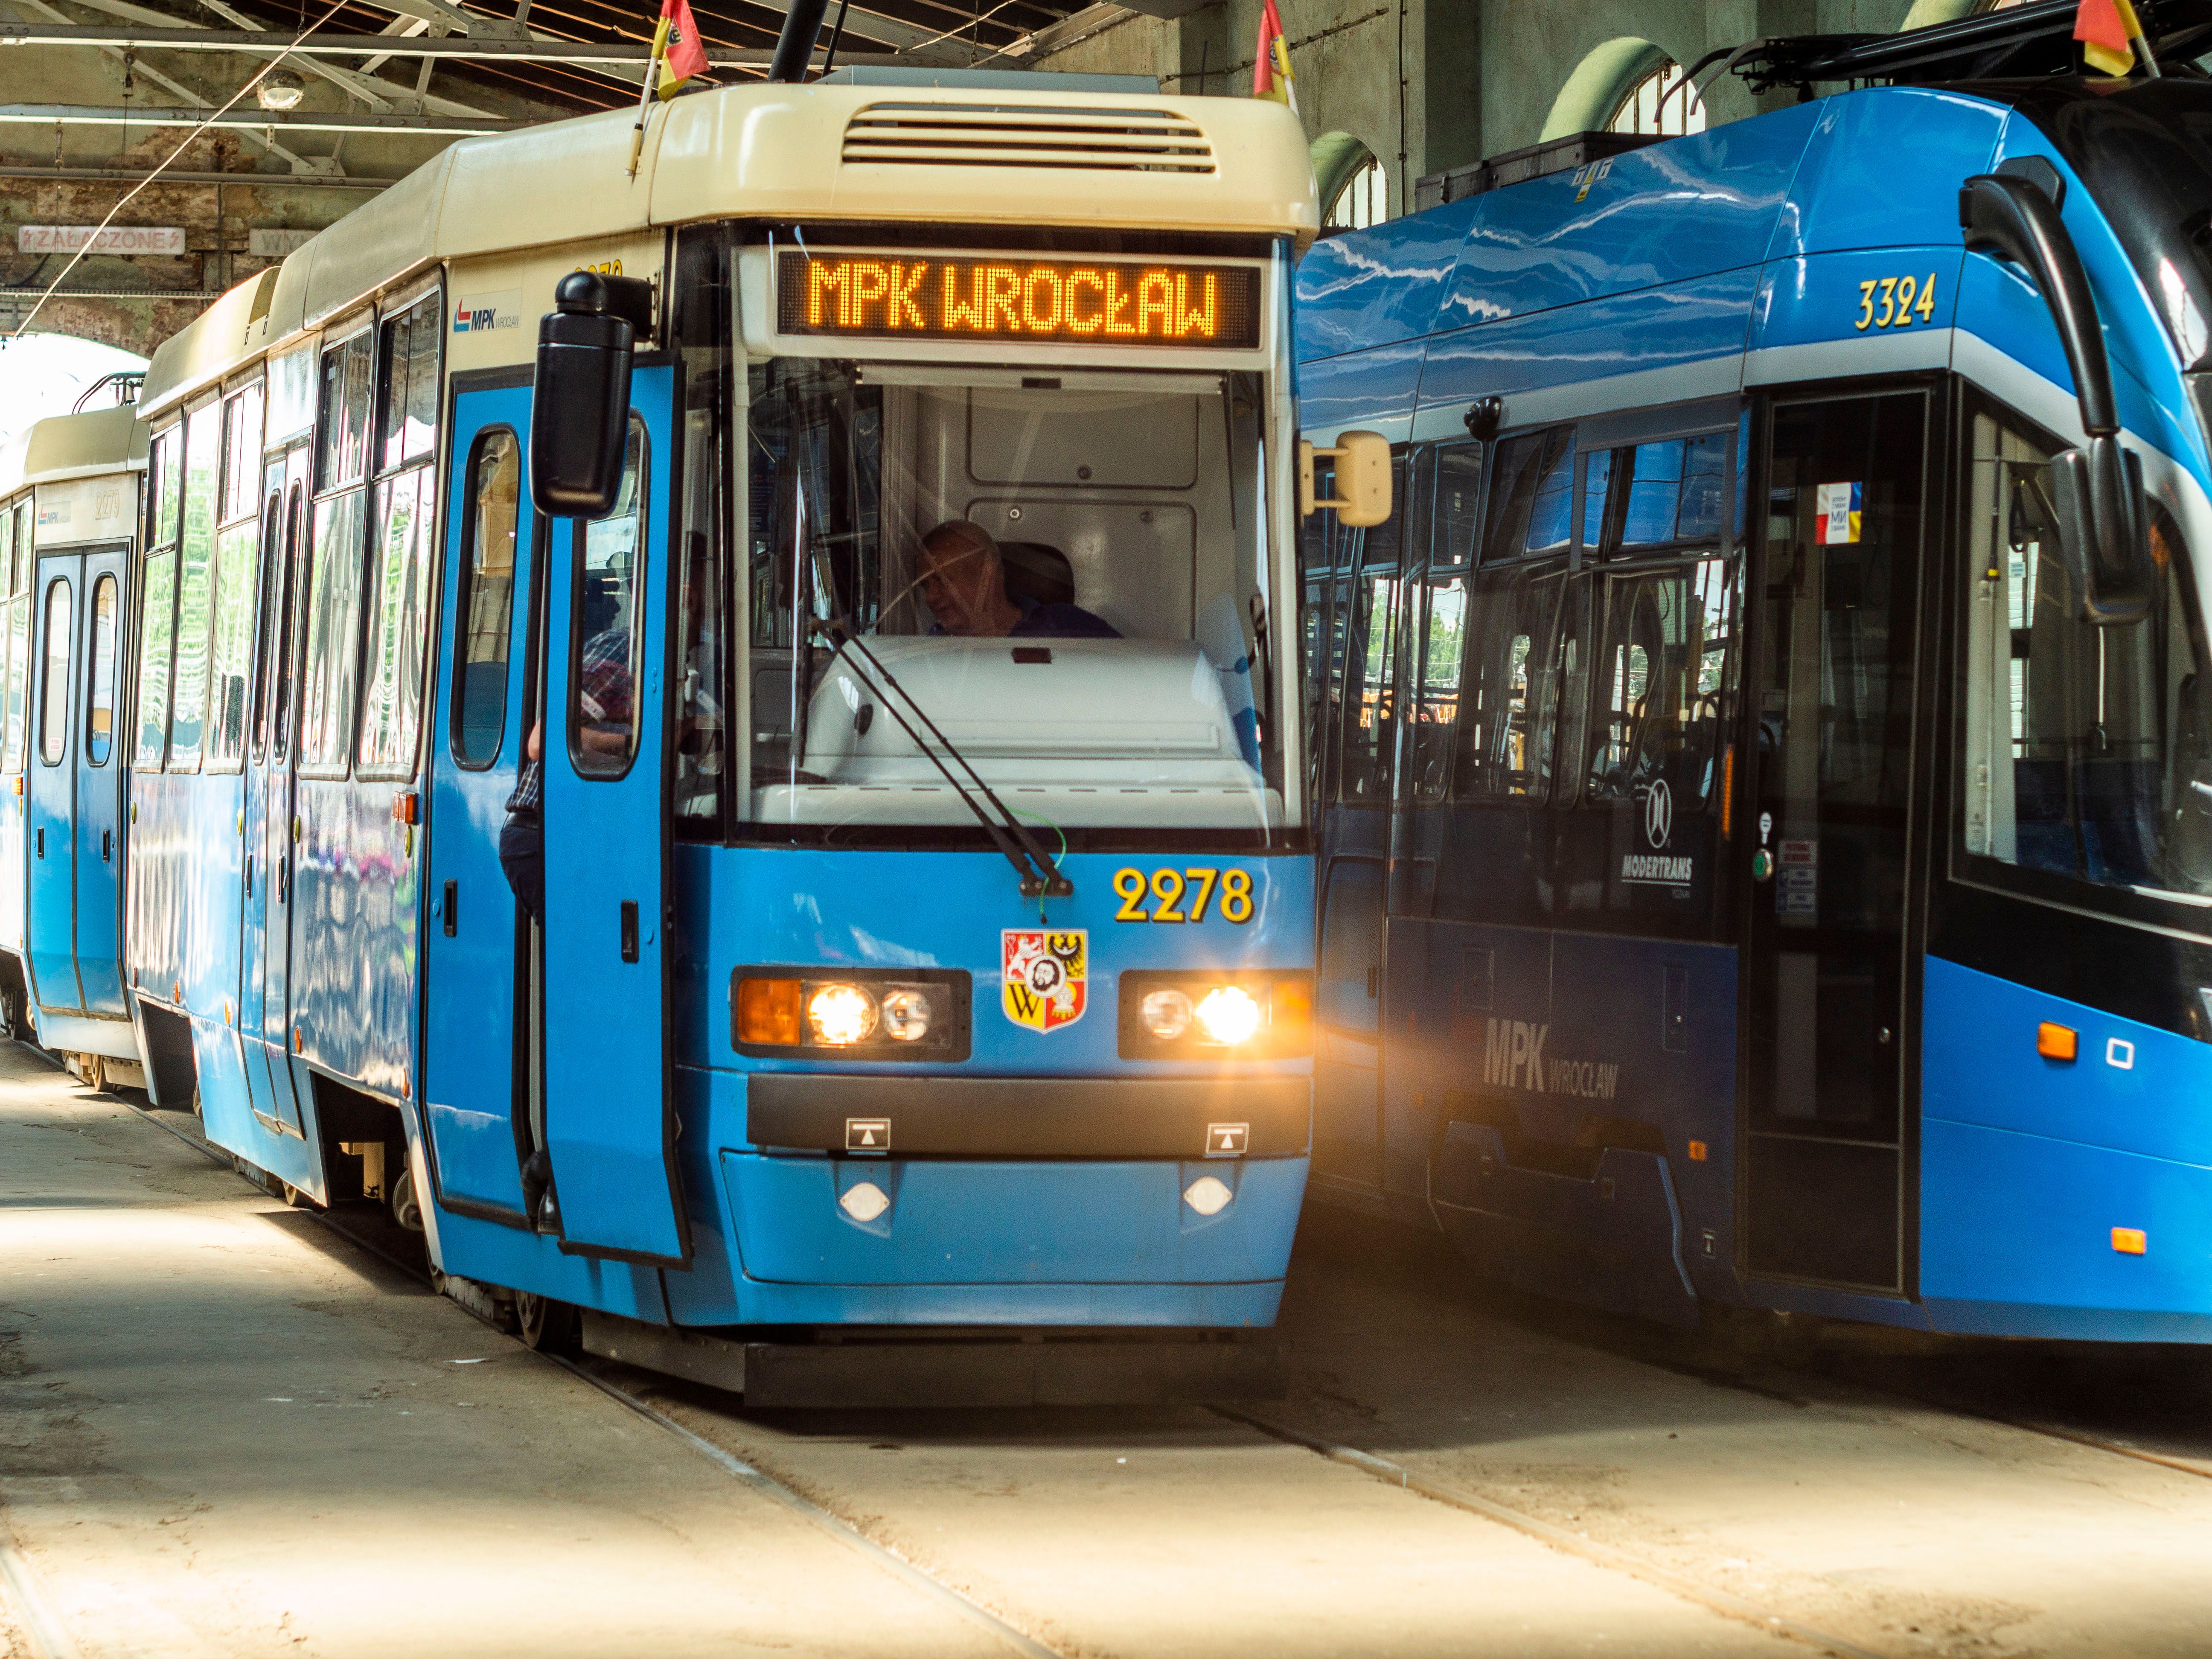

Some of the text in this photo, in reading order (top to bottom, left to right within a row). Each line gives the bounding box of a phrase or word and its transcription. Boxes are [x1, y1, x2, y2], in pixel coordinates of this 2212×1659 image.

[471, 308, 497, 331] MPK
[810, 261, 1216, 336] MPK WROCŁAW
[1854, 272, 1937, 331] 3324
[47, 511, 59, 524] MPK
[95, 489, 120, 521] 2279
[1622, 854, 1693, 881] MODERTRANS
[1112, 867, 1254, 925] 2278
[1484, 1017, 1549, 1093] MPK
